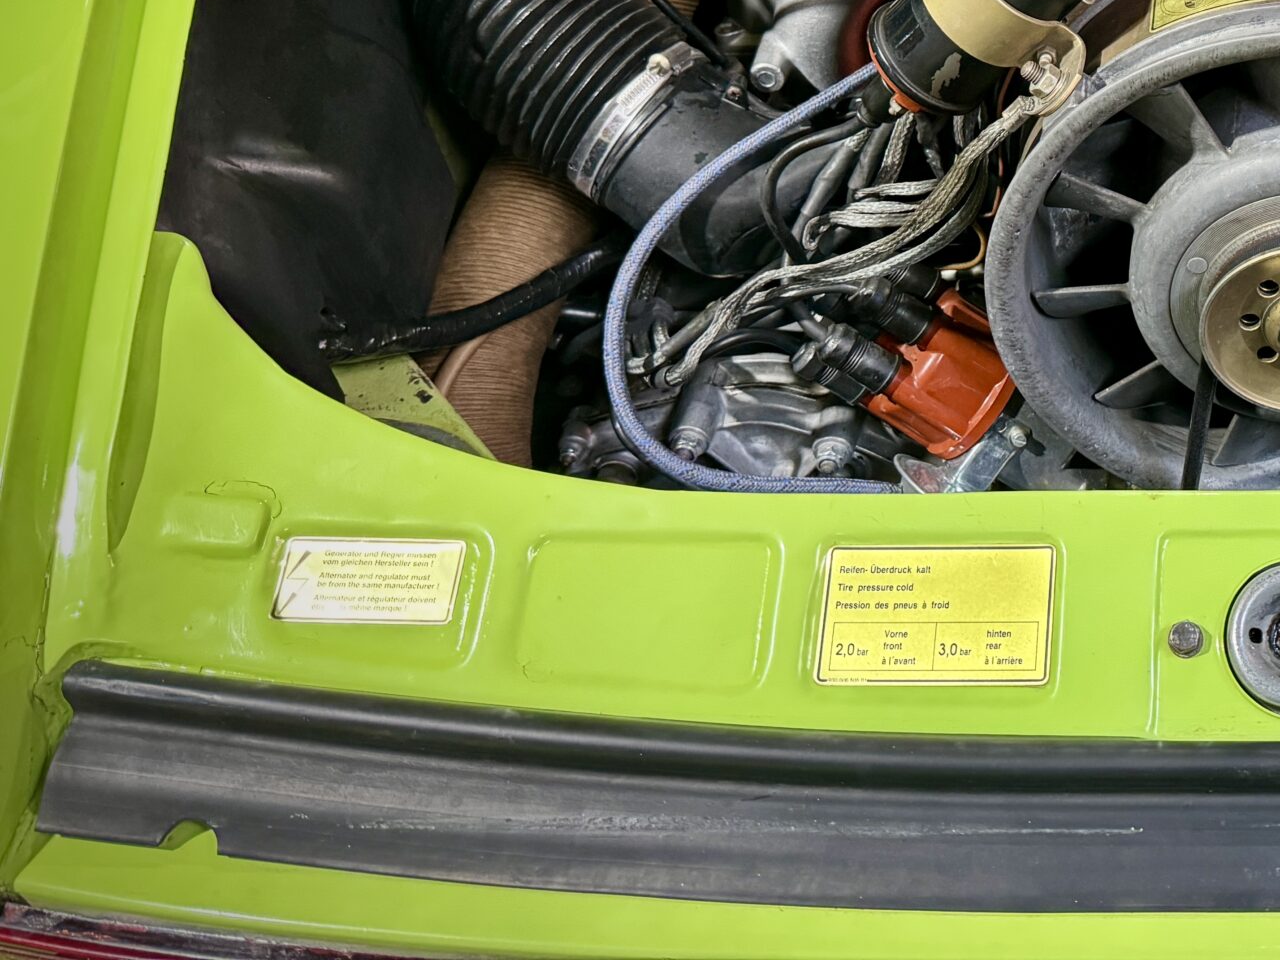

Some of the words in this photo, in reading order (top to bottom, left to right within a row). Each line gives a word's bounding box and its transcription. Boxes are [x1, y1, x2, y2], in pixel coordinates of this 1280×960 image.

[341, 559, 372, 567] gleichen
[870, 564, 911, 573] Überdruck
[375, 573, 408, 581] regulator
[838, 583, 853, 591] Tire
[858, 584, 893, 593] pressure
[896, 583, 913, 591] cold
[836, 601, 870, 609] Pression
[875, 601, 888, 609] des
[893, 602, 917, 610] pneus
[922, 600, 926, 609] à
[932, 601, 949, 609] froid
[885, 630, 908, 638] Vorne
[987, 630, 1011, 638] hinten
[835, 643, 855, 657] 2,0
[857, 648, 868, 656] bar
[883, 642, 902, 650] front
[938, 643, 957, 658] 3,0
[882, 657, 886, 665] à
[985, 656, 989, 665] à
